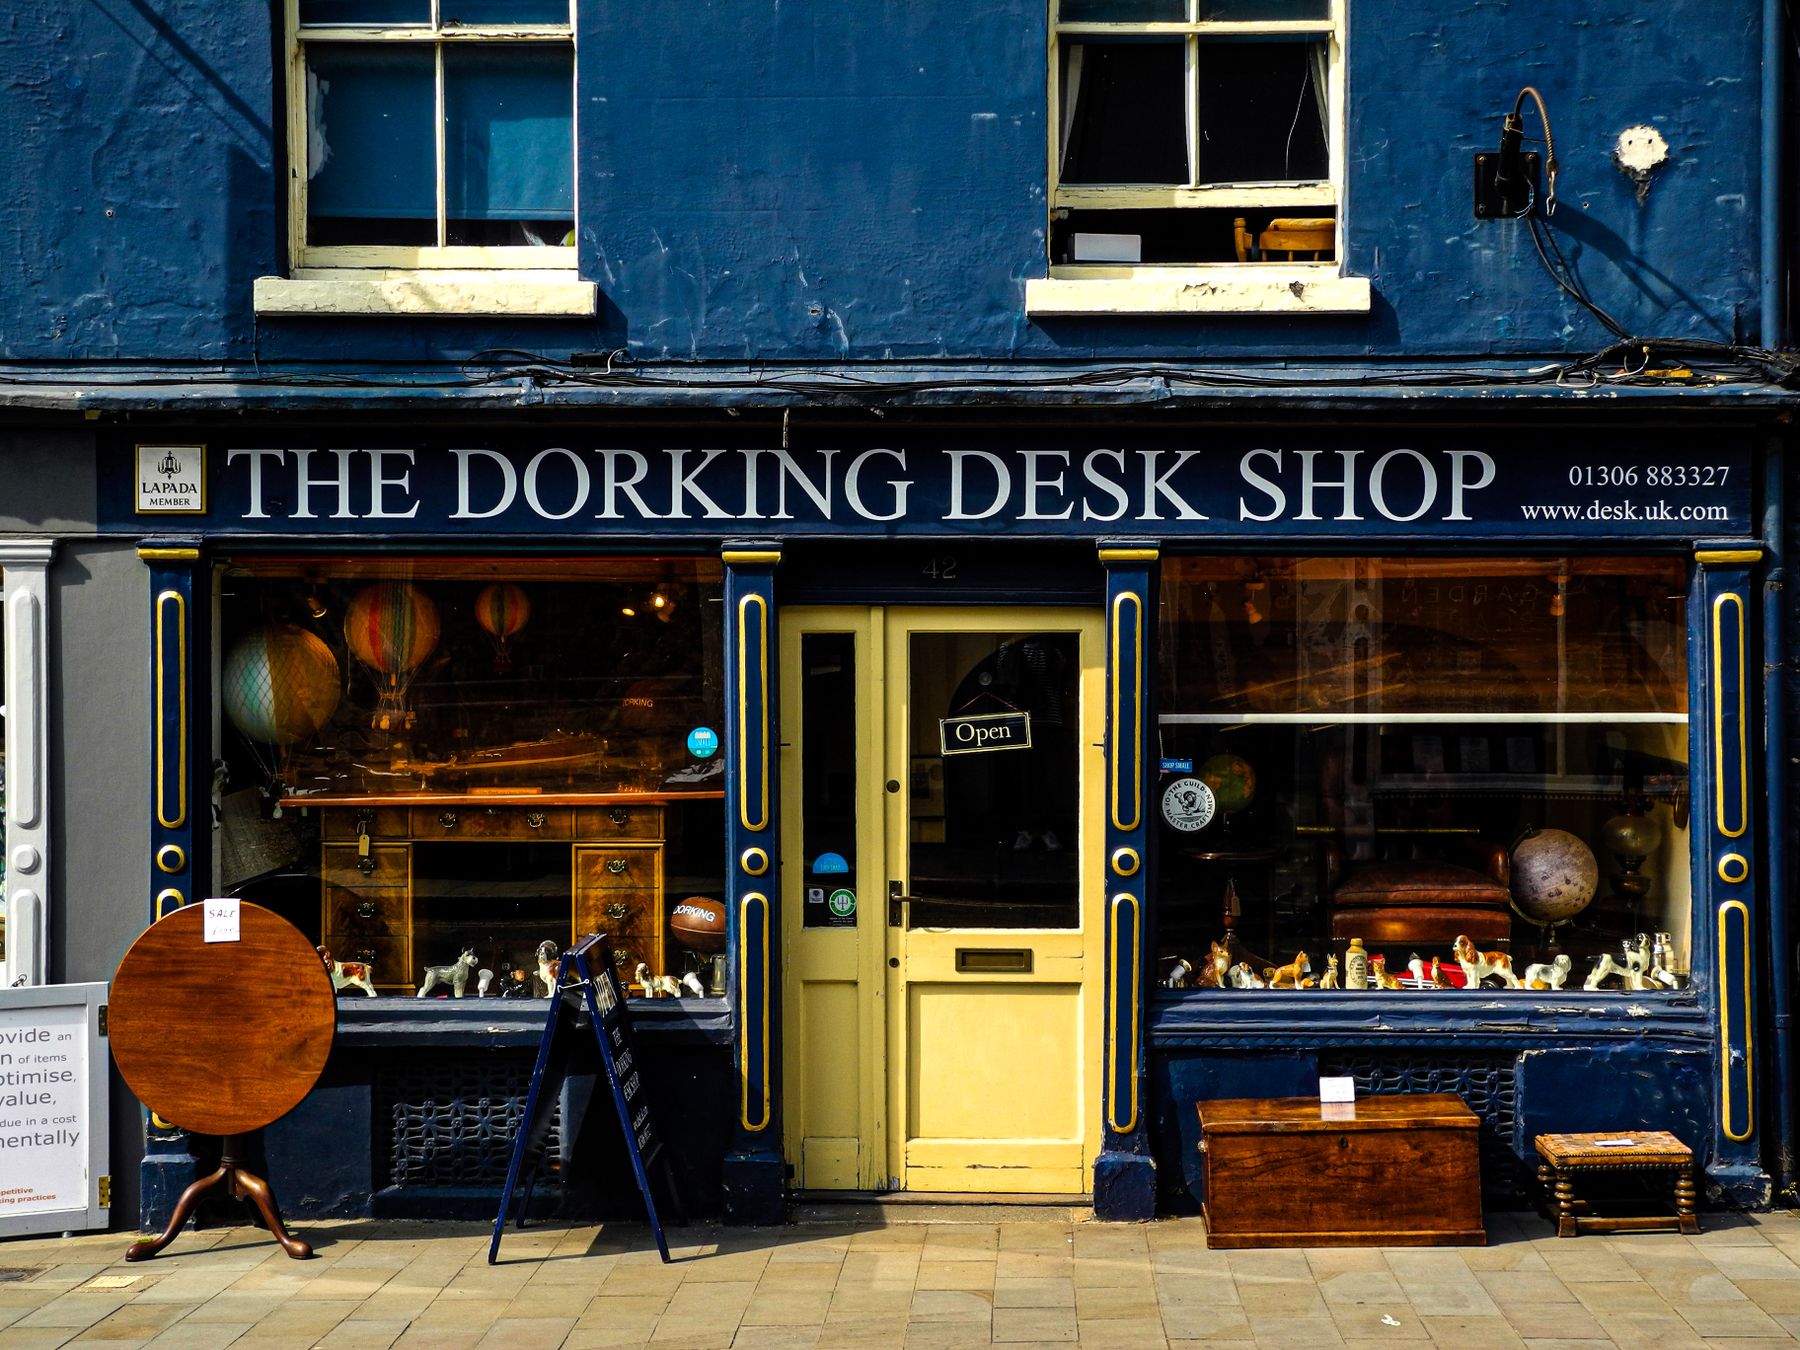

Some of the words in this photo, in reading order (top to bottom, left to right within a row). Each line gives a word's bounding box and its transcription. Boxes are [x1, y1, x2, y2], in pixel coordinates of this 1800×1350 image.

[1568, 465, 1638, 486] 01306
[1646, 465, 1730, 486] 883327
[142, 482, 198, 494] LAPADA
[227, 449, 421, 518] THE
[448, 447, 914, 520] DORKING
[941, 448, 1209, 521] DESK
[1239, 449, 1496, 521] SHOP
[149, 498, 191, 506] MEMBER
[1520, 500, 1729, 520] www.desk.uk.com
[922, 556, 957, 579] 42
[955, 722, 1012, 747] Open
[1169, 783, 1182, 794] THE
[1184, 781, 1205, 791] GUILD
[1166, 809, 1188, 828] MASTER
[1190, 794, 1212, 828] CRAFTSMEN
[57, 1032, 72, 1041] an
[18, 1055, 31, 1064] of
[34, 1053, 67, 1063] items
[0, 1119, 22, 1128] due
[26, 1117, 37, 1126] in
[41, 1117, 48, 1125] a
[52, 1115, 77, 1124] cost
[17, 1194, 57, 1203] practices
